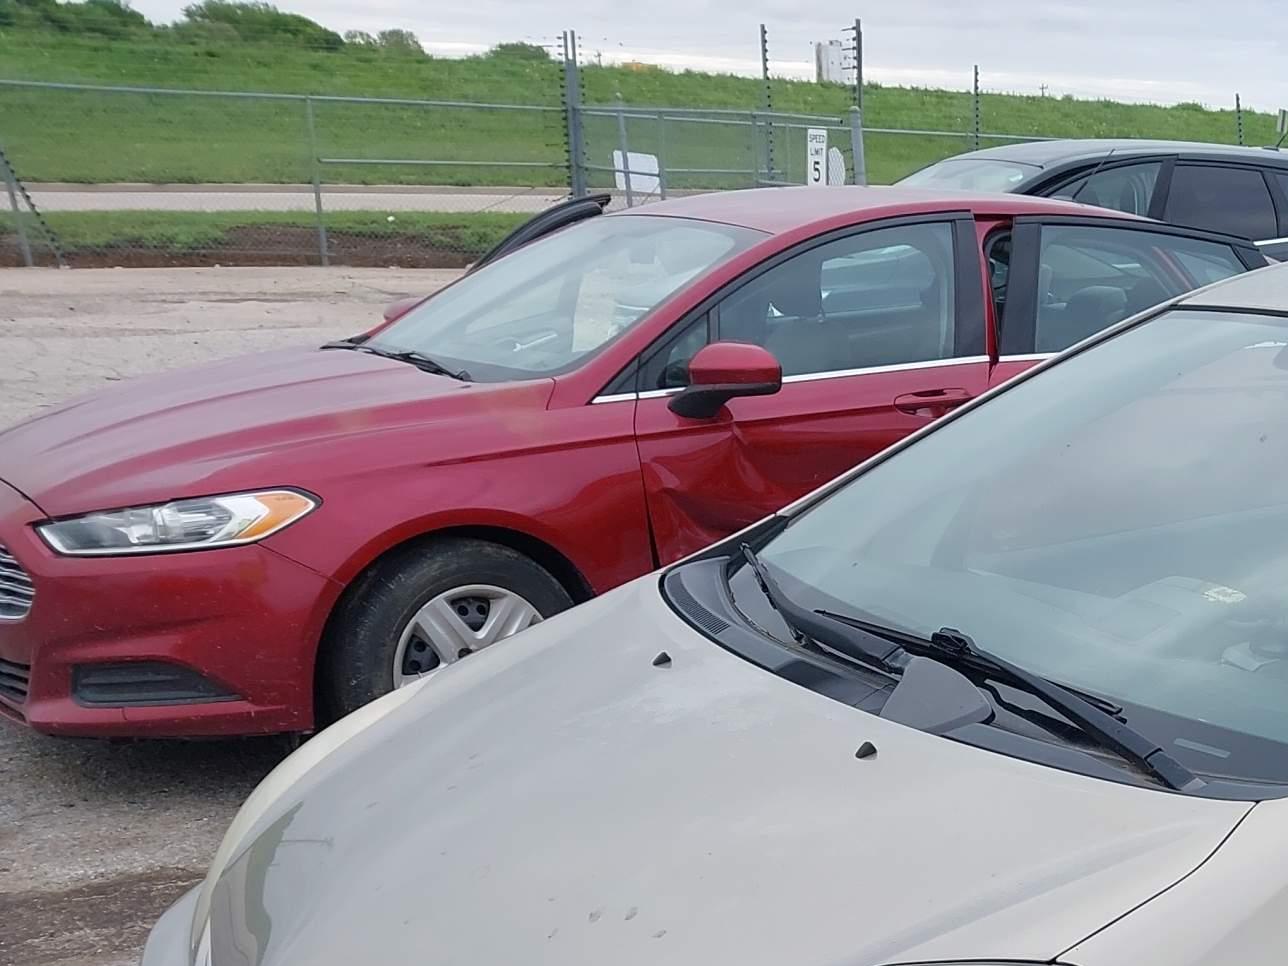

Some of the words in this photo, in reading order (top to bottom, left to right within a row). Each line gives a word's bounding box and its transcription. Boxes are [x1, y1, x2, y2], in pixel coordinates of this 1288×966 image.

[808, 133, 825, 144] SPEED
[809, 147, 824, 156] LIMIT
[812, 160, 821, 182] 5
